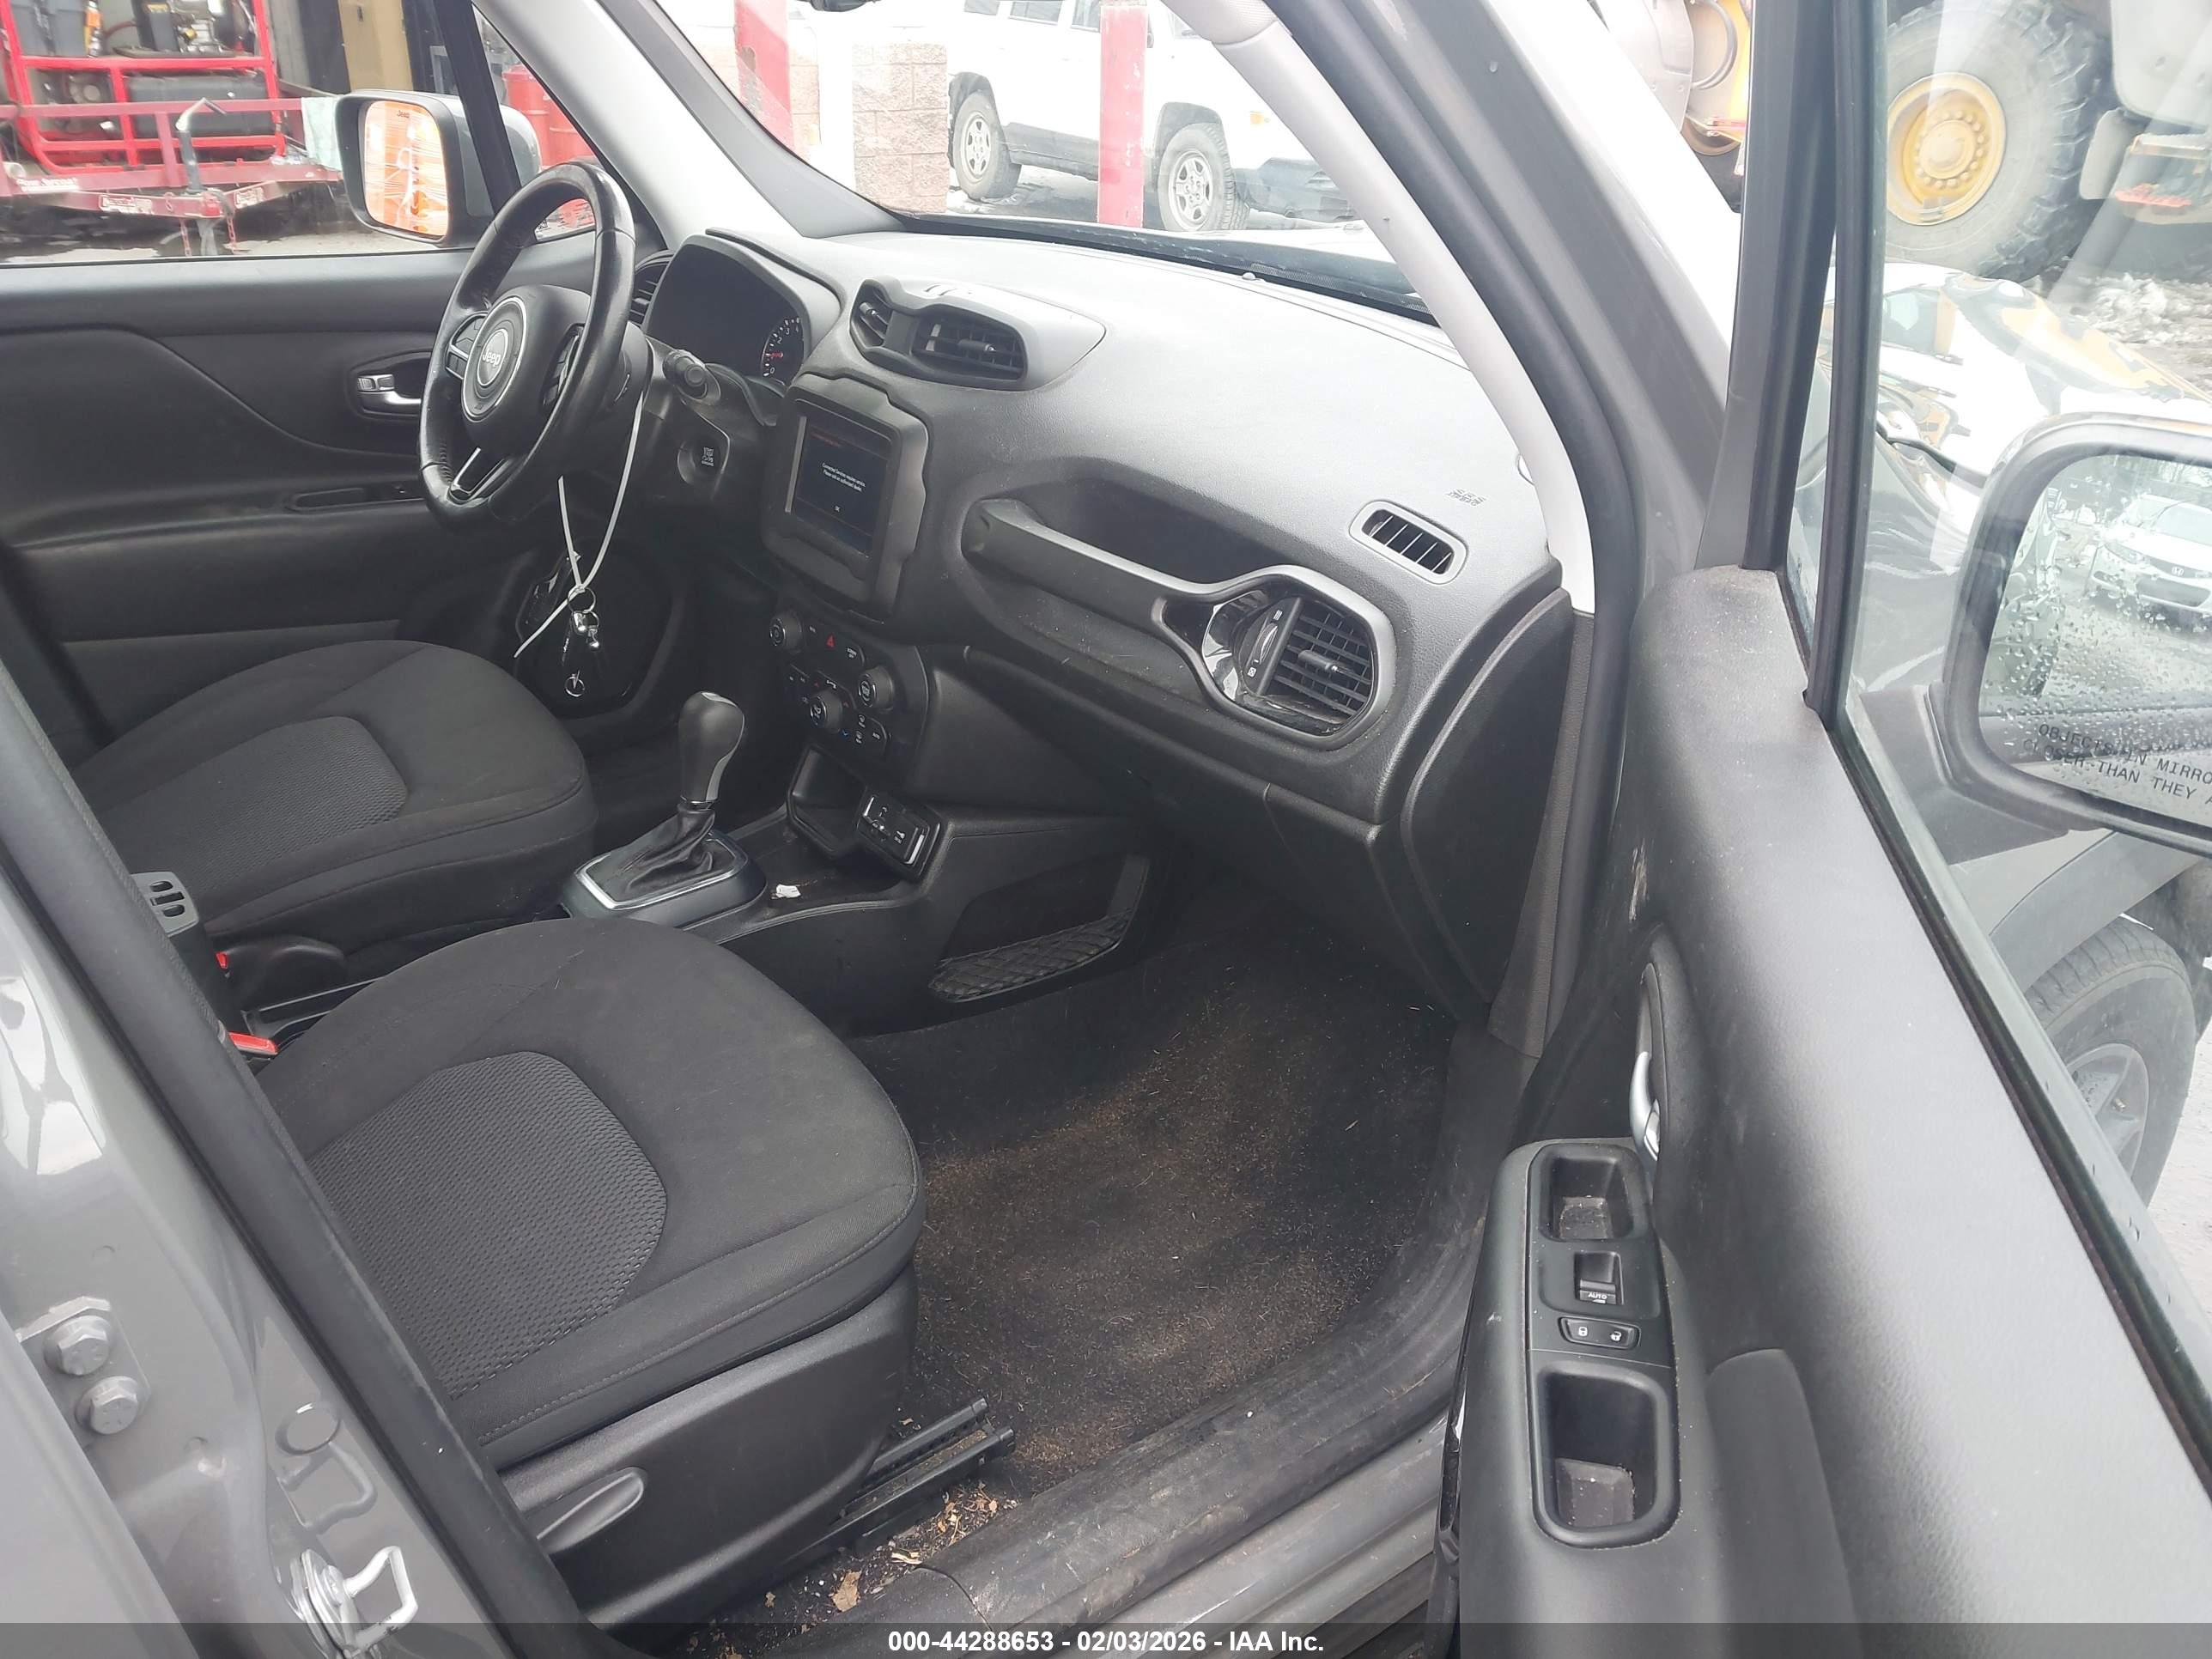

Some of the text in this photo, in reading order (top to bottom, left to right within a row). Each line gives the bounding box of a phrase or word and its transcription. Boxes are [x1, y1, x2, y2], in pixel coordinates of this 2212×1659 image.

[483, 348, 501, 367] Jeep
[2039, 724, 2114, 754] OBJECTS
[2097, 761, 2141, 784] THAN
[2152, 776, 2197, 799] THEY
